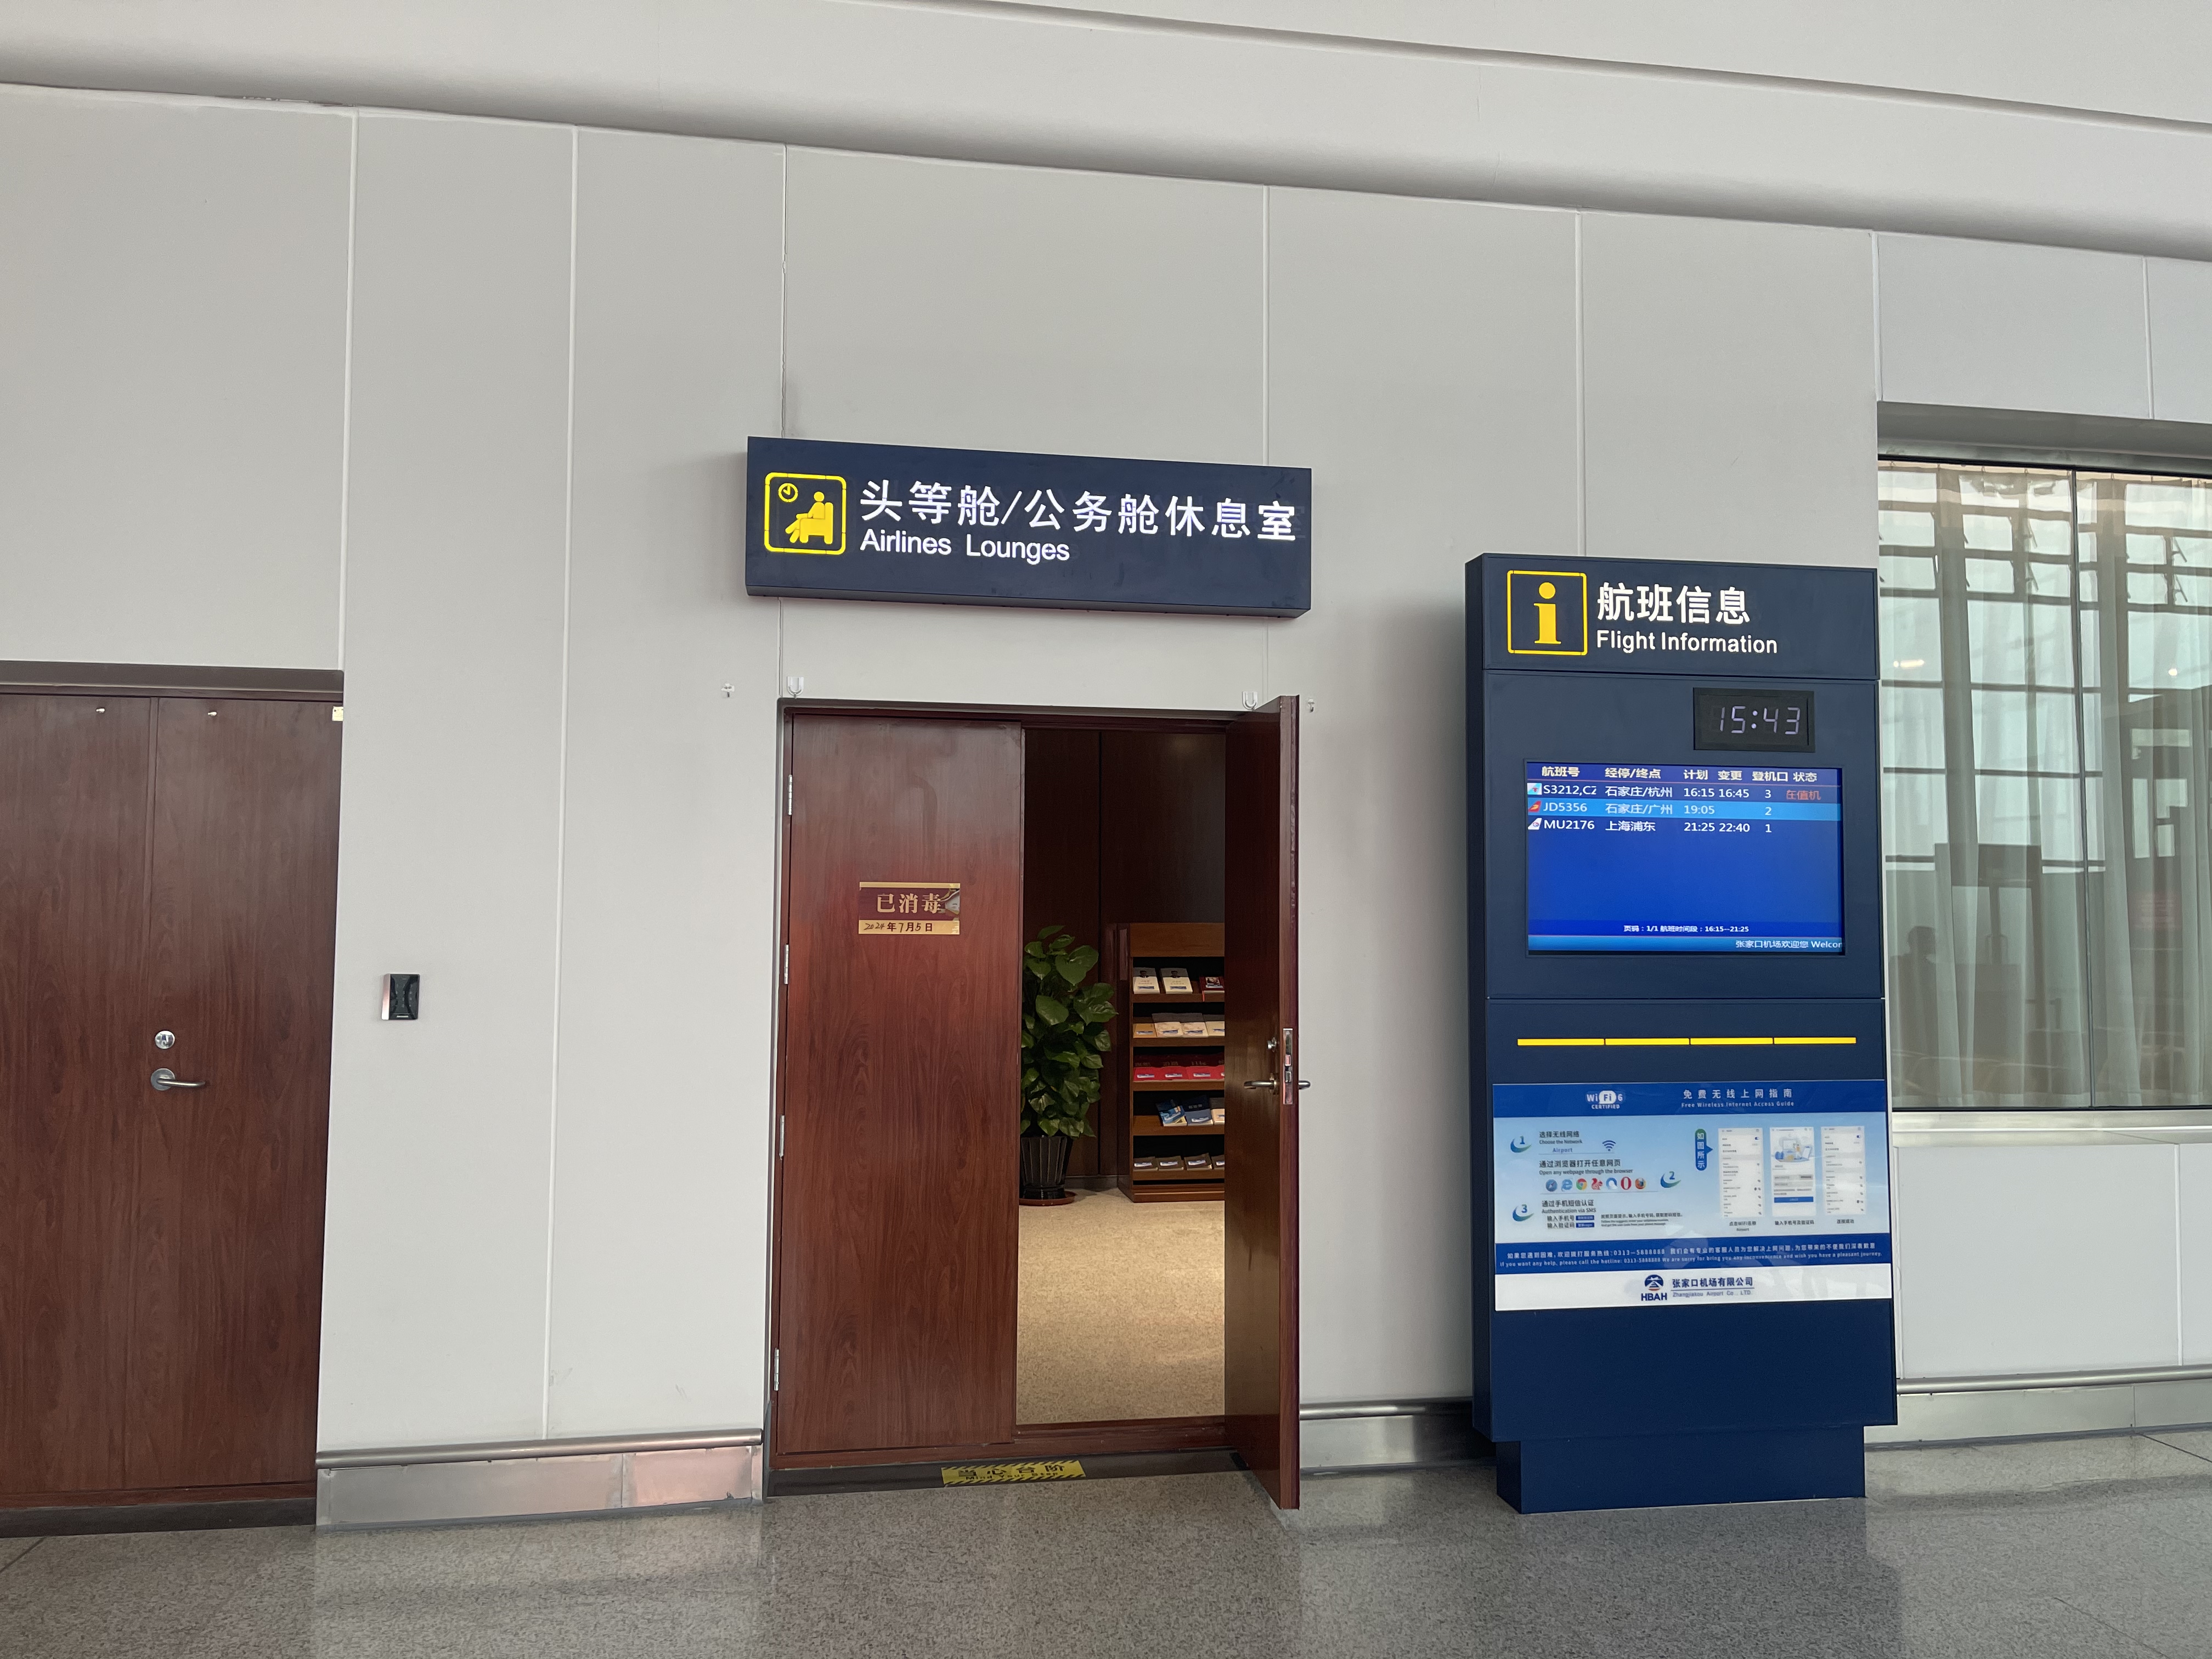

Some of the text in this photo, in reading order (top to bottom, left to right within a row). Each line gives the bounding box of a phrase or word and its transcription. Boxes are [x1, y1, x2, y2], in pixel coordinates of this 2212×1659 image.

[860, 480, 1297, 541] 头等舱/公务舱休息室
[860, 528, 1070, 565] Airlines Lounges
[1597, 582, 1750, 624] 航班信息
[1597, 630, 1778, 653] Flight Information
[1719, 706, 1801, 735] 15:43
[1542, 766, 1818, 782] 航班号 经停/终点 计划 变更 登机口 状态
[1605, 786, 1672, 798] 石家庄/杭州
[1684, 788, 1715, 797] 16:15
[1718, 789, 1750, 798] 16:45
[1765, 790, 1771, 798] 3
[1543, 802, 1772, 816] JD5356 石家庄/广州 19:05 2
[1544, 820, 1772, 833] MU2176 上海浦东 21:25 22:40 1
[877, 893, 941, 914] 已消毒
[1735, 940, 1809, 949] 张家口机场欢迎您
[1683, 1088, 1792, 1099] 免费无线上网指南
[1539, 1159, 1621, 1168] 通过浏览器打开任意网页
[1672, 1277, 1753, 1288] 张家口机场有限公司
[1641, 1293, 1667, 1301] HBAH
